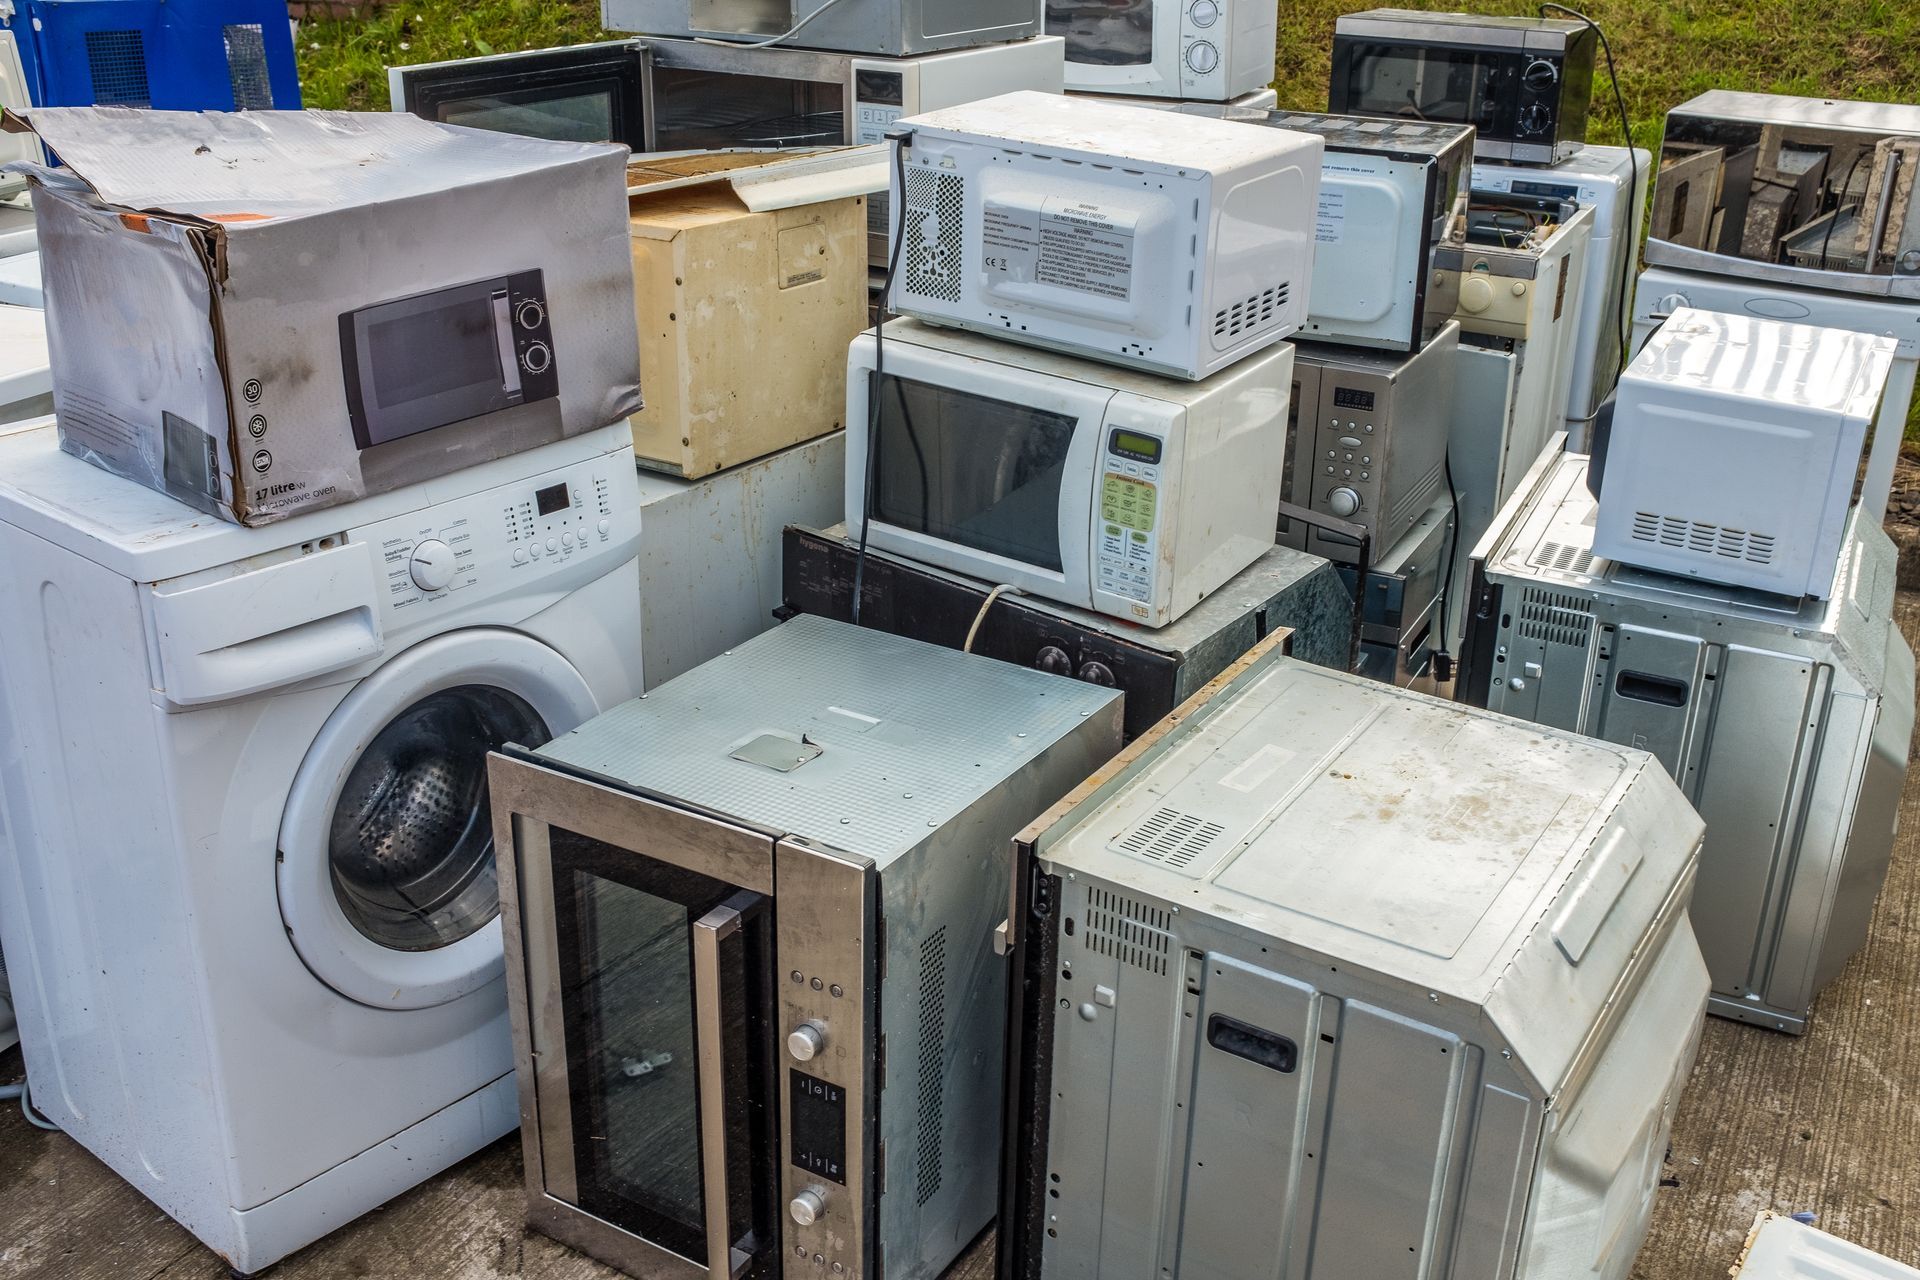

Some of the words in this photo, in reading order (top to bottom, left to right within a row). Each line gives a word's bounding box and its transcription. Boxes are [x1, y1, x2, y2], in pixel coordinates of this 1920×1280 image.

[1064, 207, 1087, 217] MICROWAVE
[1088, 212, 1106, 220] ENERGY
[1070, 217, 1087, 225] REMOVE
[1073, 227, 1093, 235] WARNING
[986, 257, 996, 267] CE
[247, 384, 258, 394] 30
[256, 489, 268, 500] 17
[270, 481, 296, 496] litre
[313, 485, 336, 498] oven
